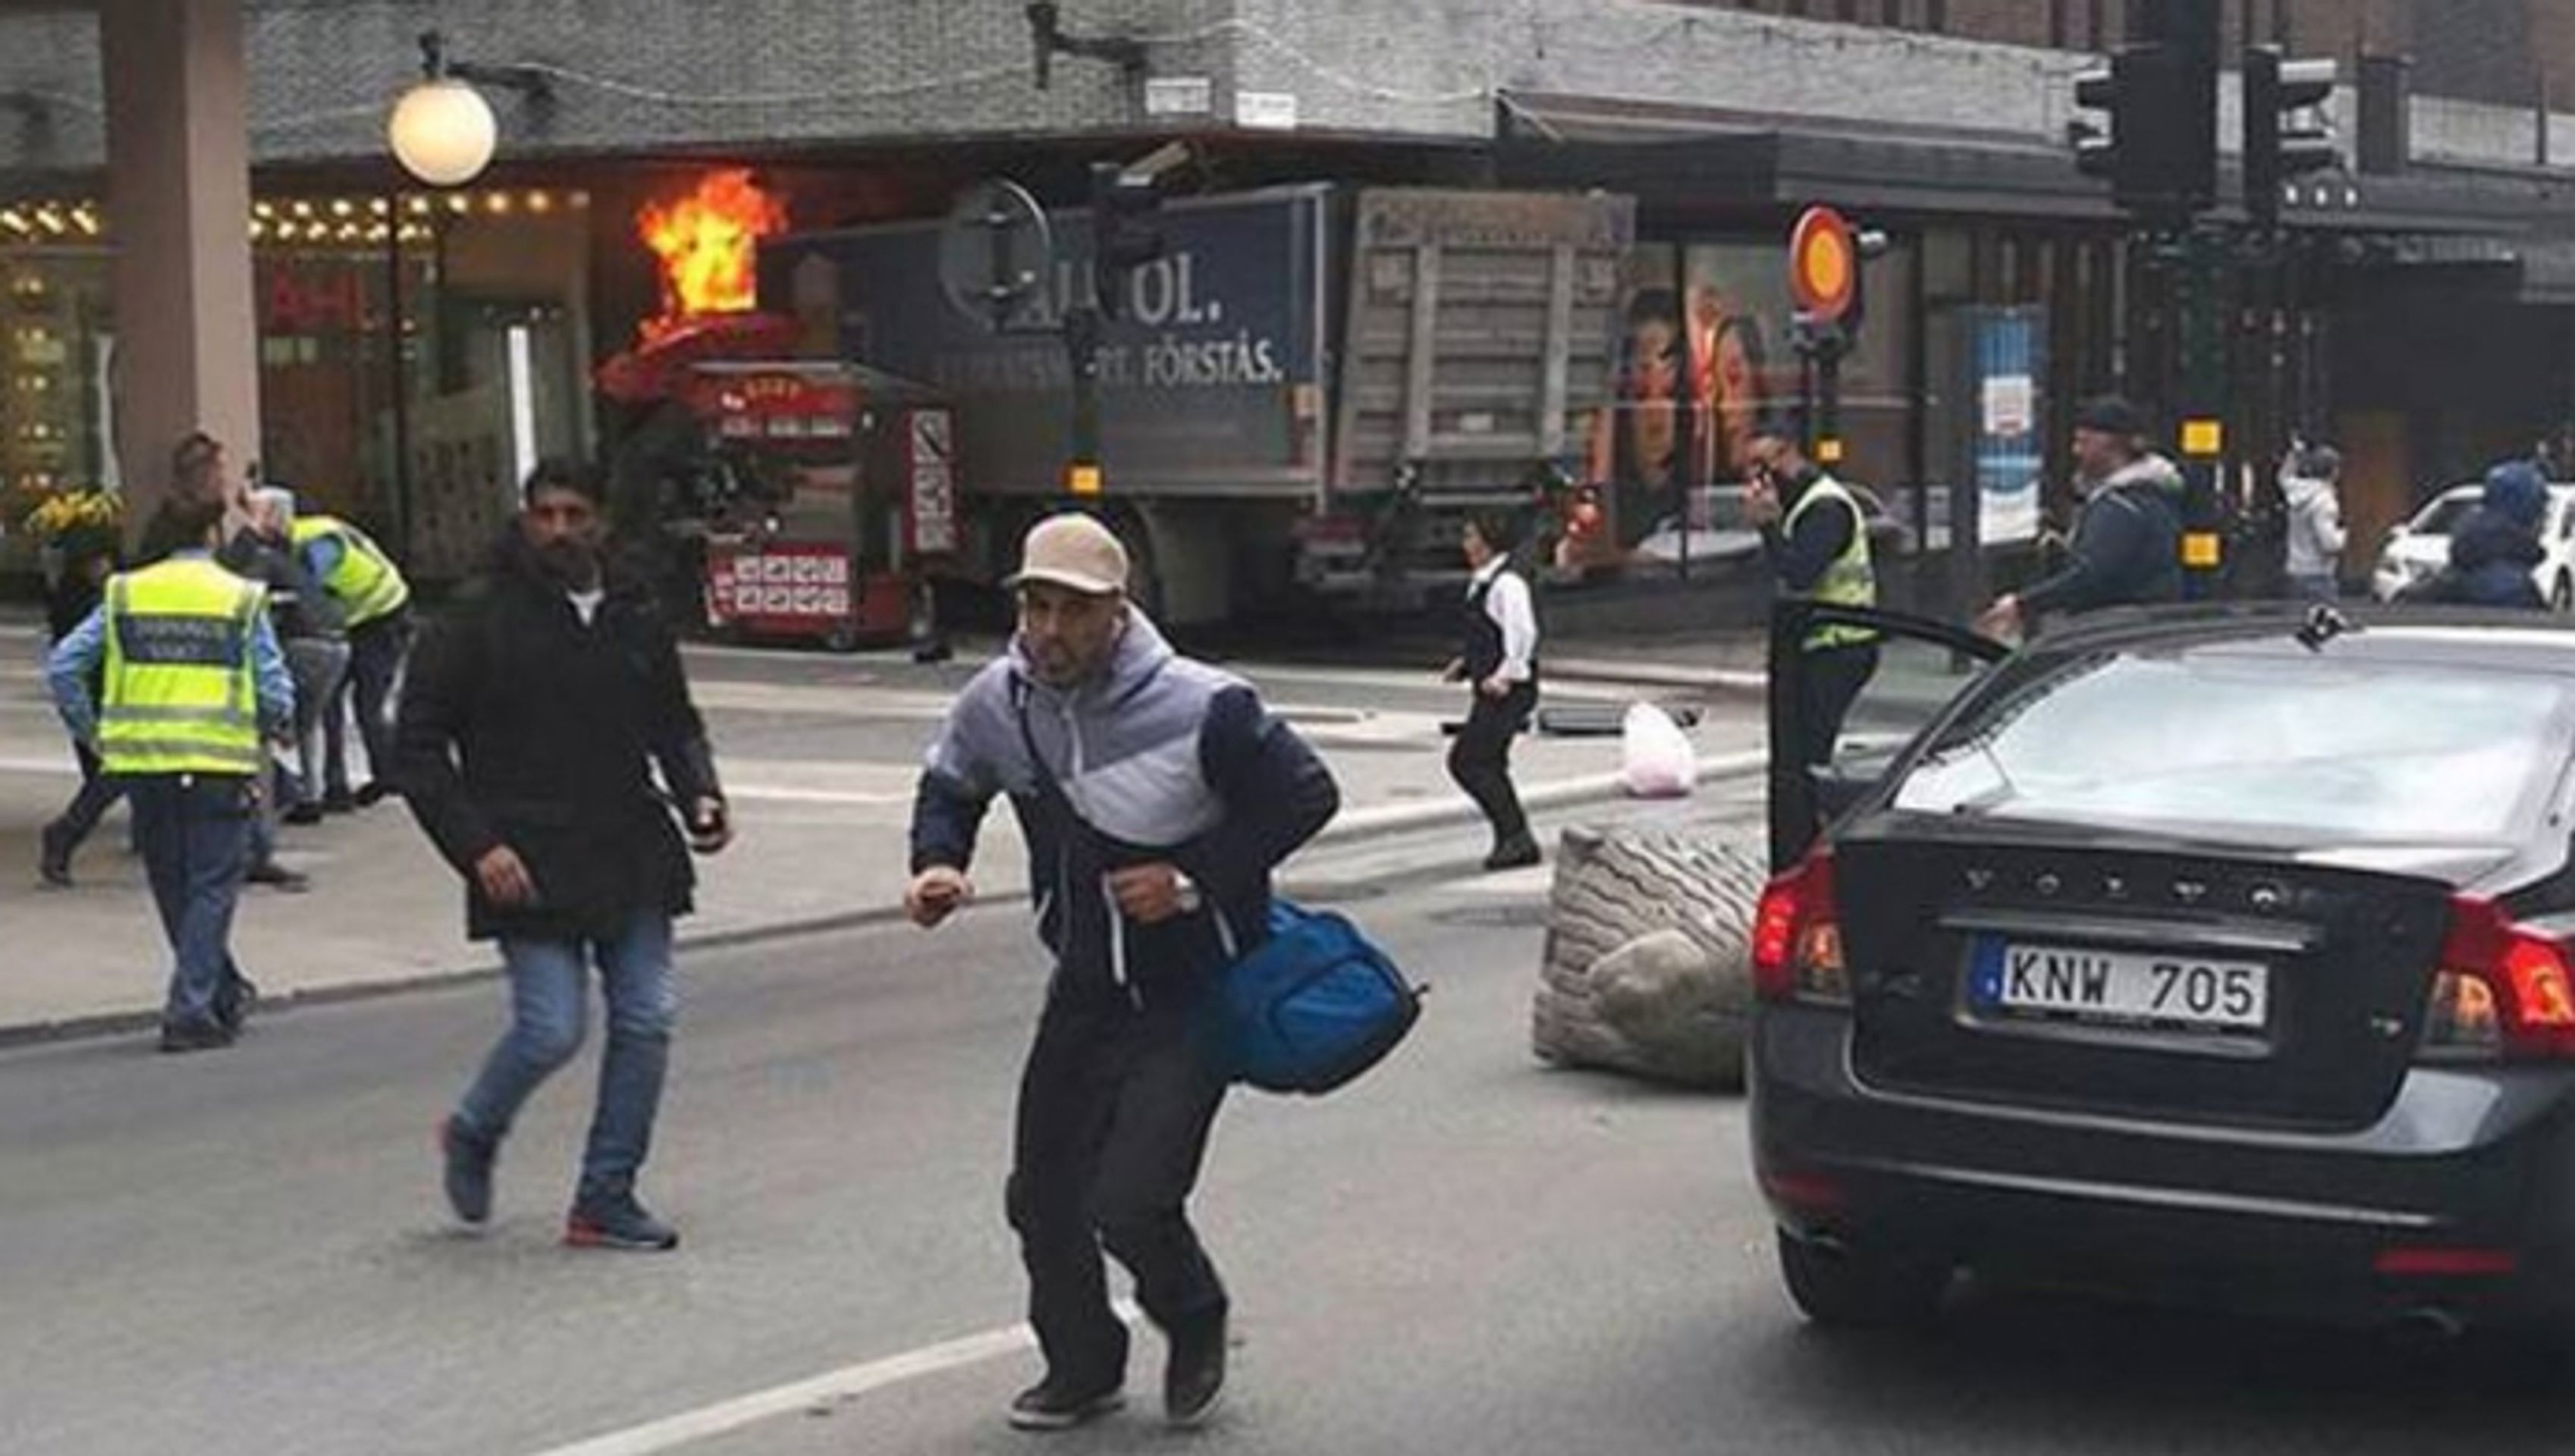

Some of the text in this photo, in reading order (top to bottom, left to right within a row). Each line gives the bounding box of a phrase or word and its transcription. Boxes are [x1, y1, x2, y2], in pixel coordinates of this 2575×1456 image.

[1144, 328, 1283, 388] FÖRSTÅS.
[1967, 869, 2280, 908] VOLVO
[2009, 952, 2253, 1017] KNW 705
